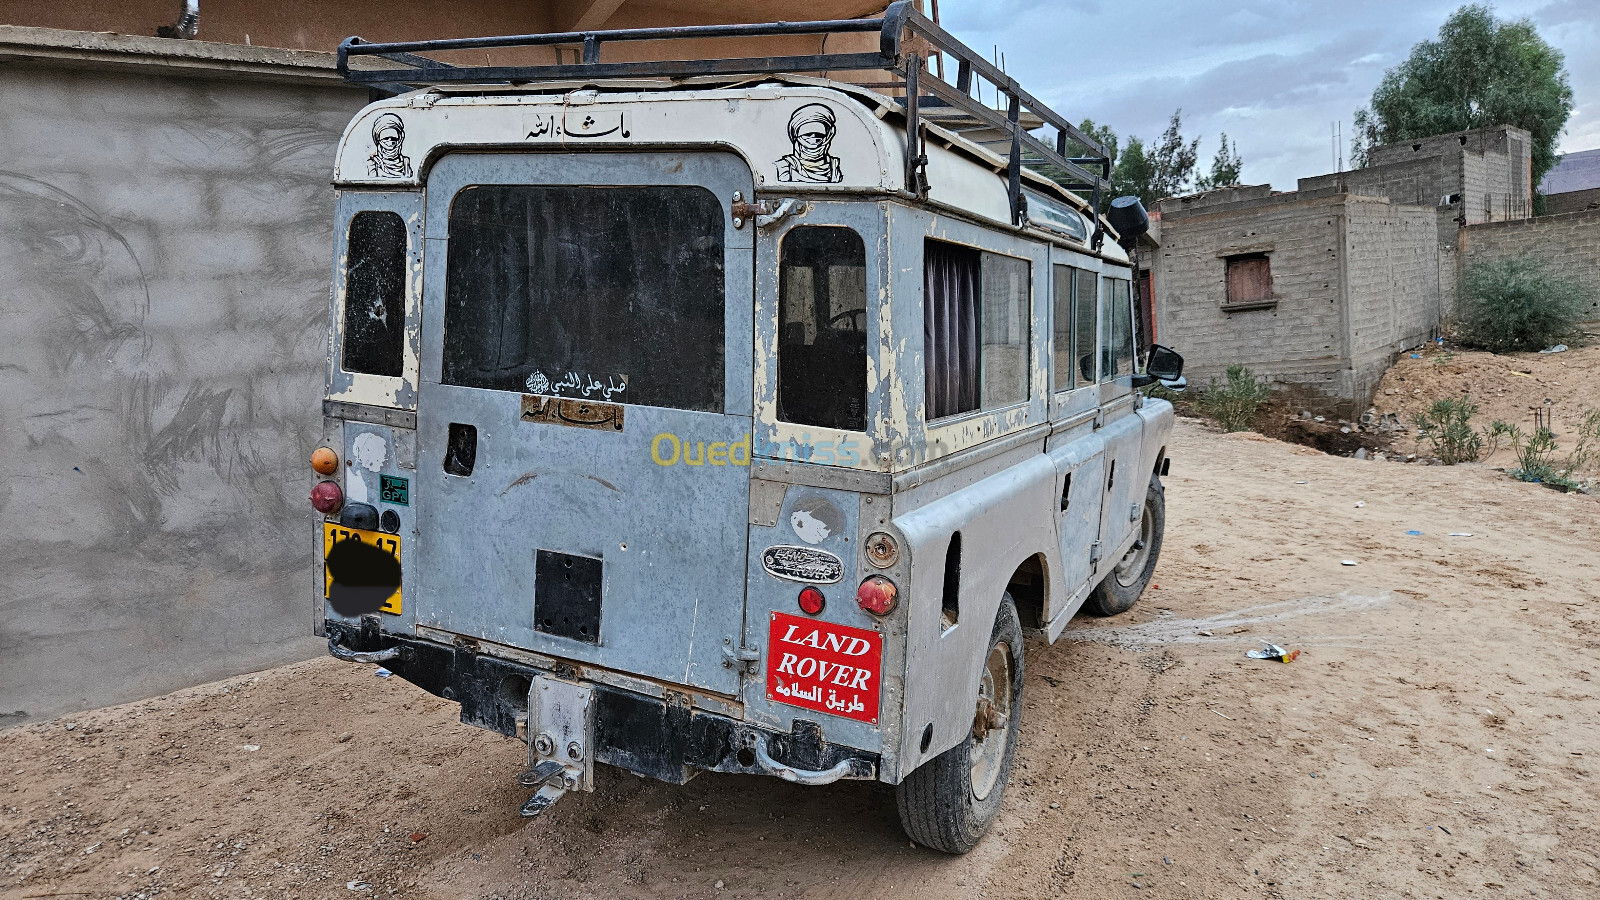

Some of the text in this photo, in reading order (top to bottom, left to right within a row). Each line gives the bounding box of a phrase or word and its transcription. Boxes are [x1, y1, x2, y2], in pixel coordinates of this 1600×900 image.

[382, 490, 408, 503] GPL
[774, 549, 808, 562] LAND
[793, 564, 834, 580] ROVER
[780, 624, 871, 657] LAND
[776, 652, 872, 691] ROVER
[825, 688, 865, 713] طريق
